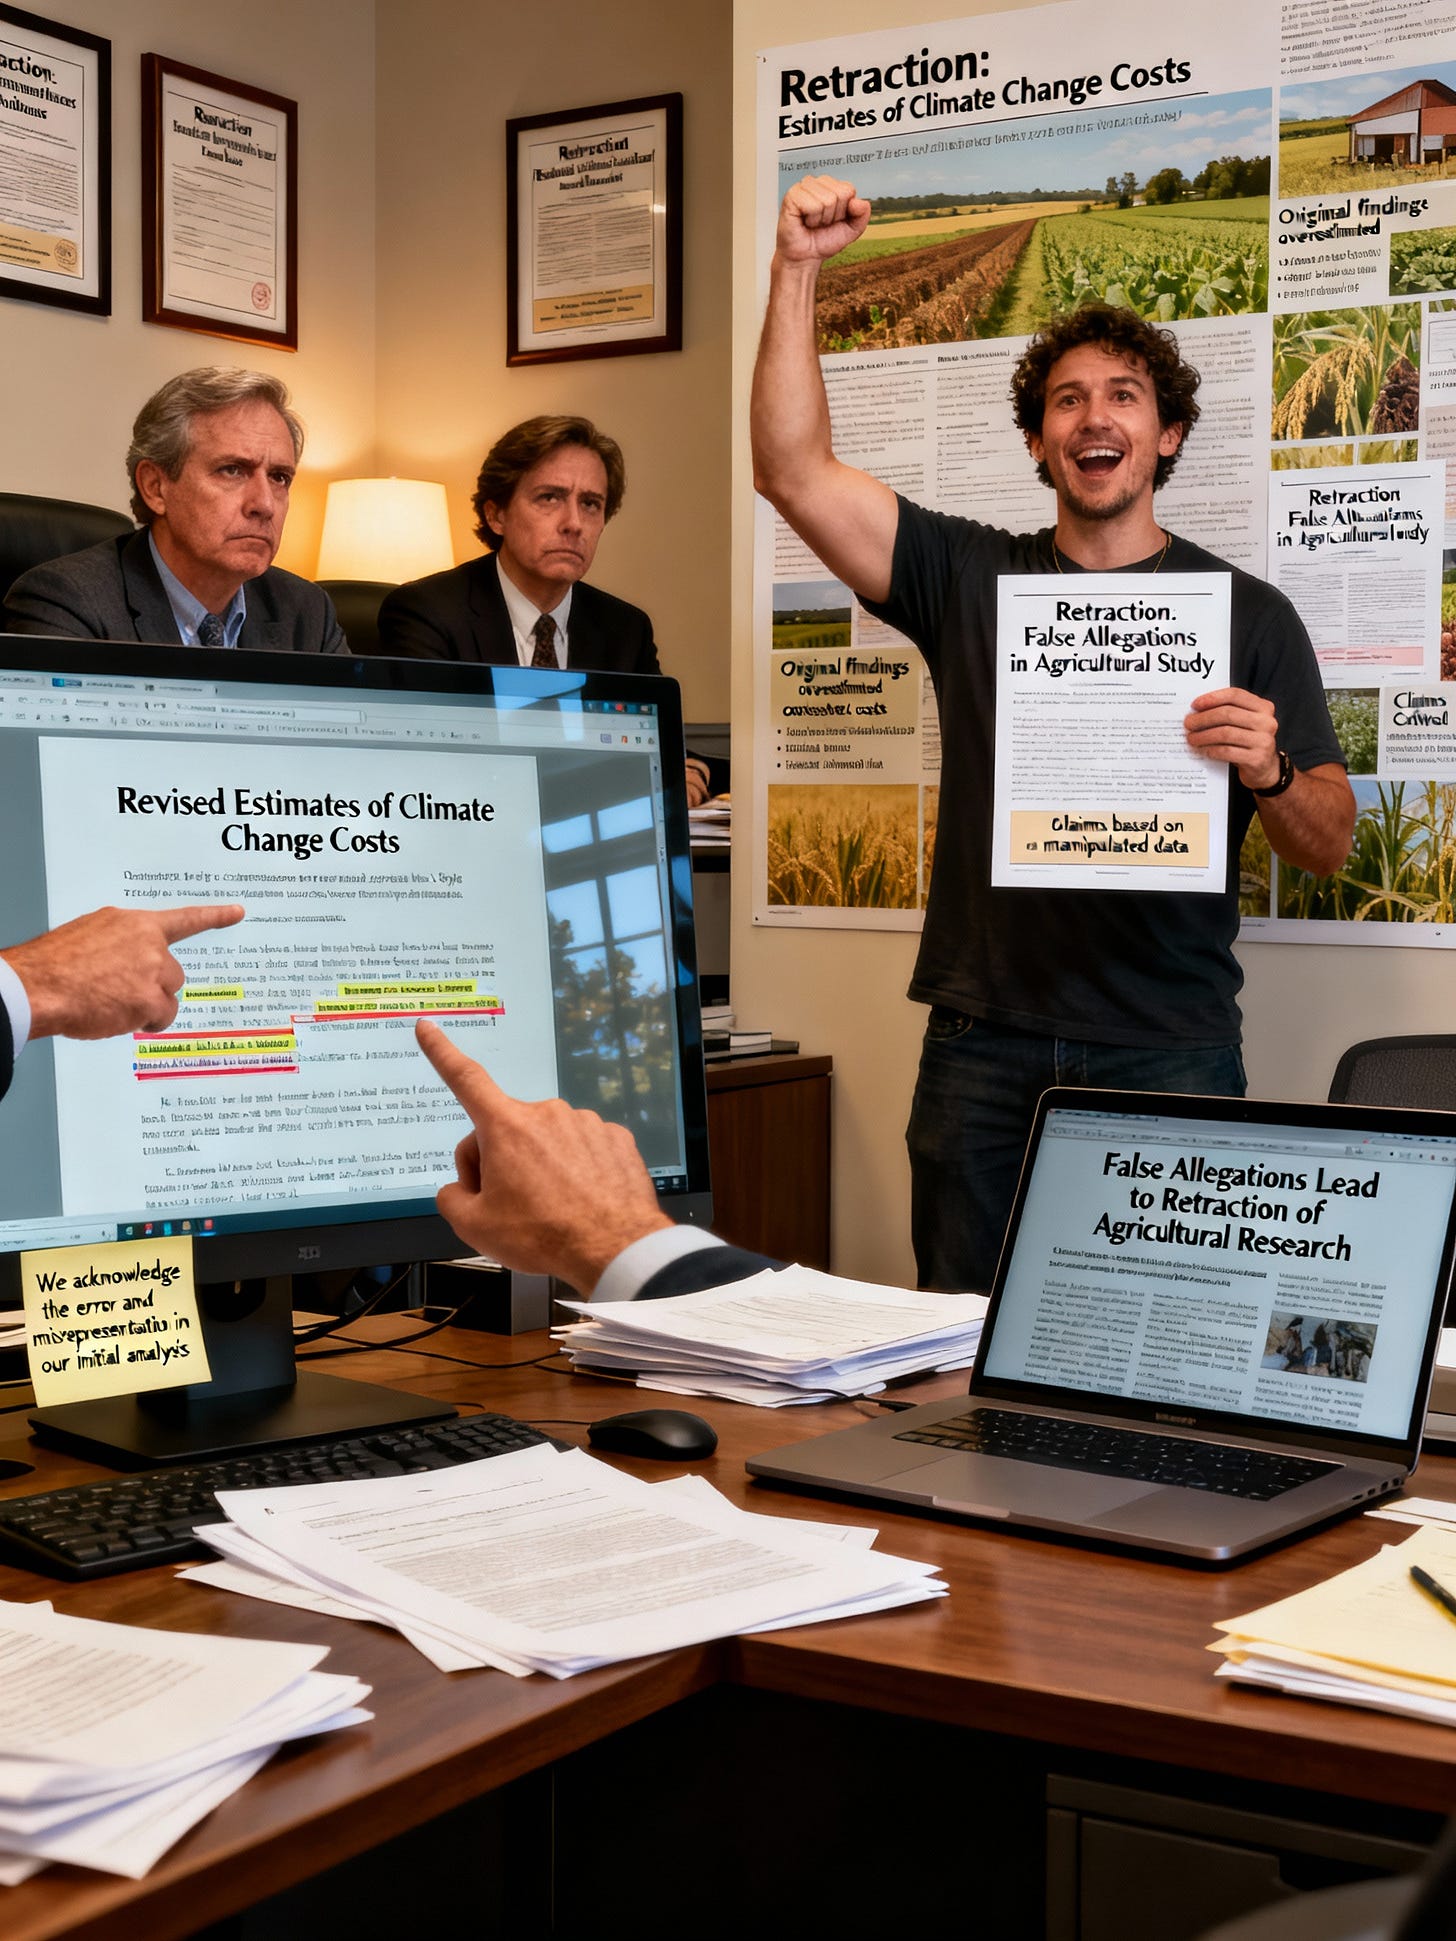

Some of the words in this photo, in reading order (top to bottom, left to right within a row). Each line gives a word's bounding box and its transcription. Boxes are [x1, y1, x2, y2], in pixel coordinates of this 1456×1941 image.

[781, 48, 989, 107] Retraction:
[883, 97, 905, 122] of
[910, 88, 996, 119] Climate
[1002, 76, 1103, 105] Change
[1110, 58, 1191, 91] Costs
[1276, 532, 1292, 546] in
[1024, 626, 1076, 646] False
[1082, 625, 1197, 653] Allegations
[1010, 653, 1028, 672] in
[1034, 652, 1150, 677] Agricultural
[1158, 652, 1215, 679] Study
[117, 786, 226, 815] Revised
[235, 788, 361, 818] Estimates
[368, 792, 394, 818] of
[400, 793, 495, 822] Climate
[1112, 813, 1158, 832] based
[1164, 822, 1184, 832] on
[221, 823, 324, 860] Change
[329, 826, 400, 853] Costs
[1154, 836, 1189, 853] data
[1103, 1152, 1164, 1180] False
[1169, 1156, 1307, 1192] Allegations
[1316, 1168, 1380, 1198] Lead
[1130, 1187, 1155, 1209] to
[1161, 1188, 1288, 1222] Retraction
[1296, 1200, 1328, 1225] of
[1092, 1212, 1231, 1245] Agricultural
[1238, 1226, 1352, 1262] Research
[36, 1271, 67, 1293] We
[73, 1258, 181, 1287] acknowledge
[42, 1299, 69, 1320] the
[76, 1300, 116, 1316] error
[175, 1311, 190, 1330] in
[42, 1356, 70, 1373] our
